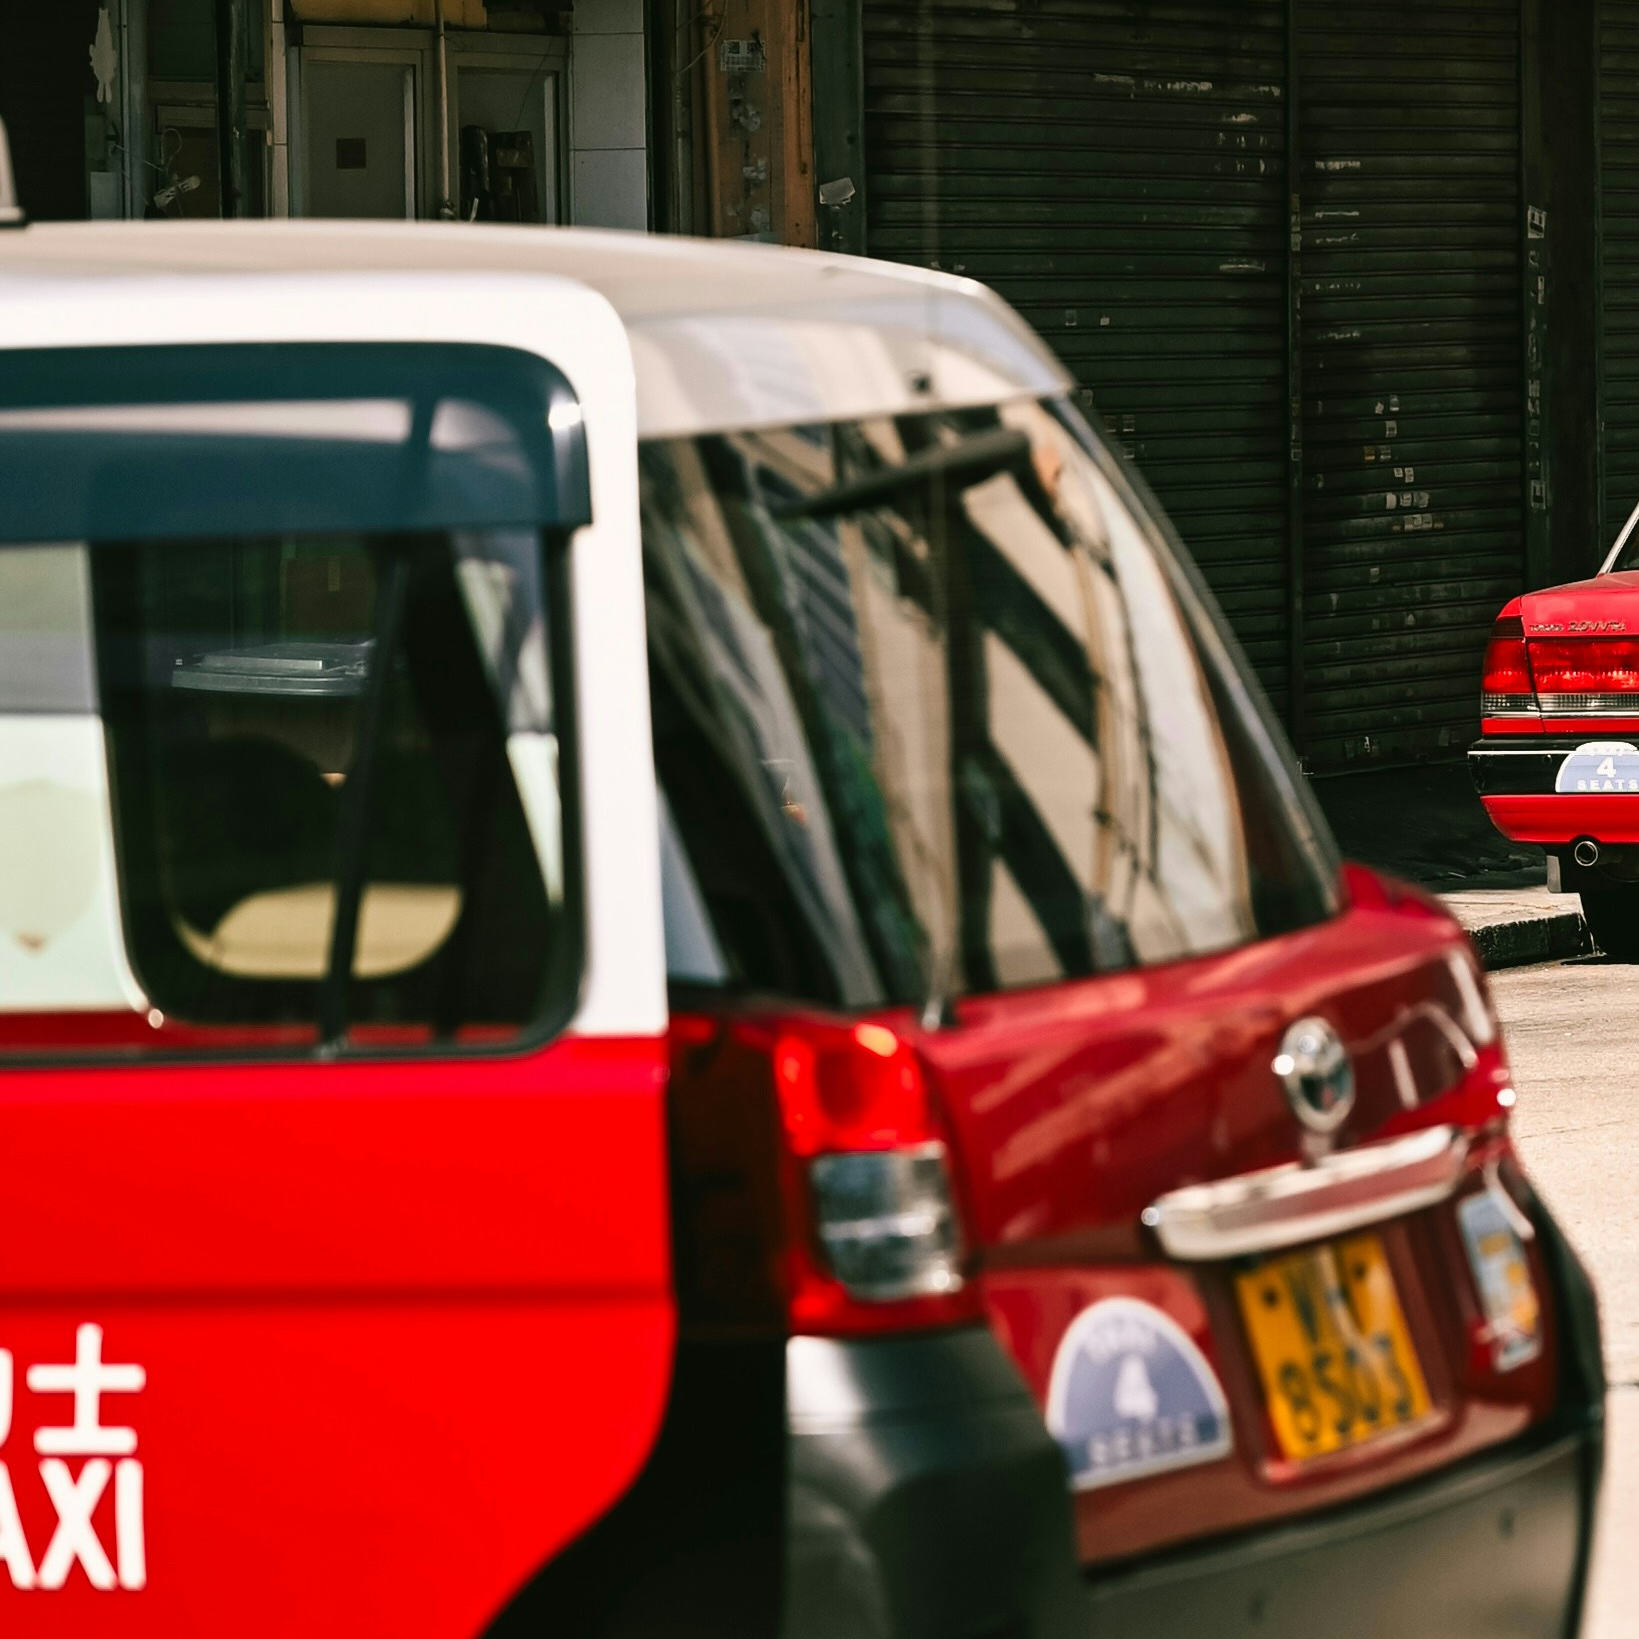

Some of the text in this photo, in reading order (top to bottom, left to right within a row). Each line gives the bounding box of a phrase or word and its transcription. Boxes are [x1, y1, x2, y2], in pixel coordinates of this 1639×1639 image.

[1596, 756, 1617, 778] 4
[1576, 778, 1639, 791] SEATS
[0, 1322, 148, 1456] 士
